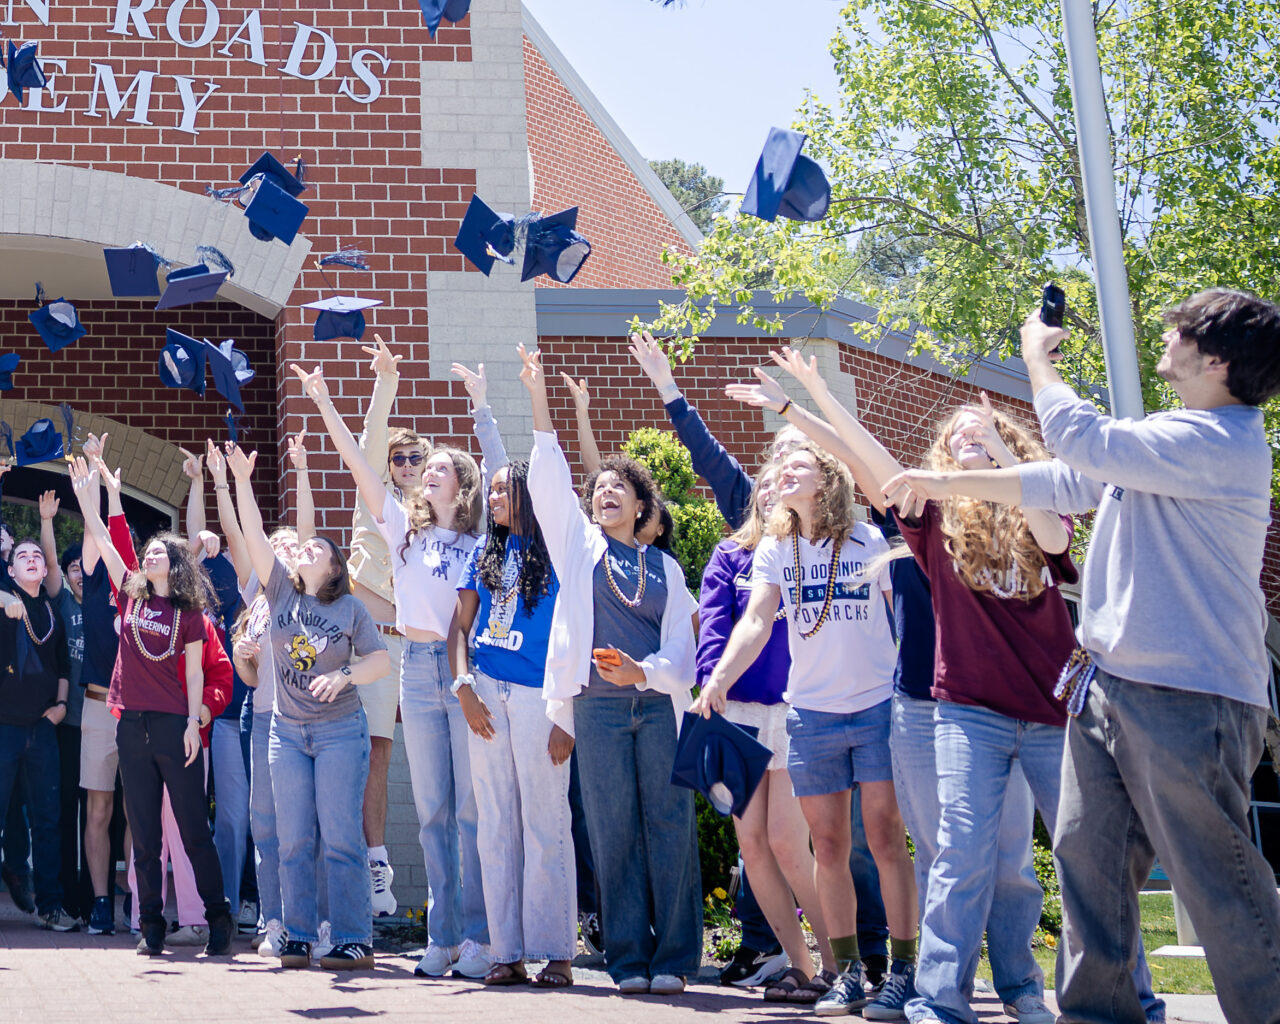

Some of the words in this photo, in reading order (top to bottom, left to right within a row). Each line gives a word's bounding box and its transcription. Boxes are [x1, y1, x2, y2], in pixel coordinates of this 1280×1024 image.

[807, 586, 869, 598] SALING
[794, 604, 869, 624] ONARCHS
[125, 613, 171, 636] ENINEERING
